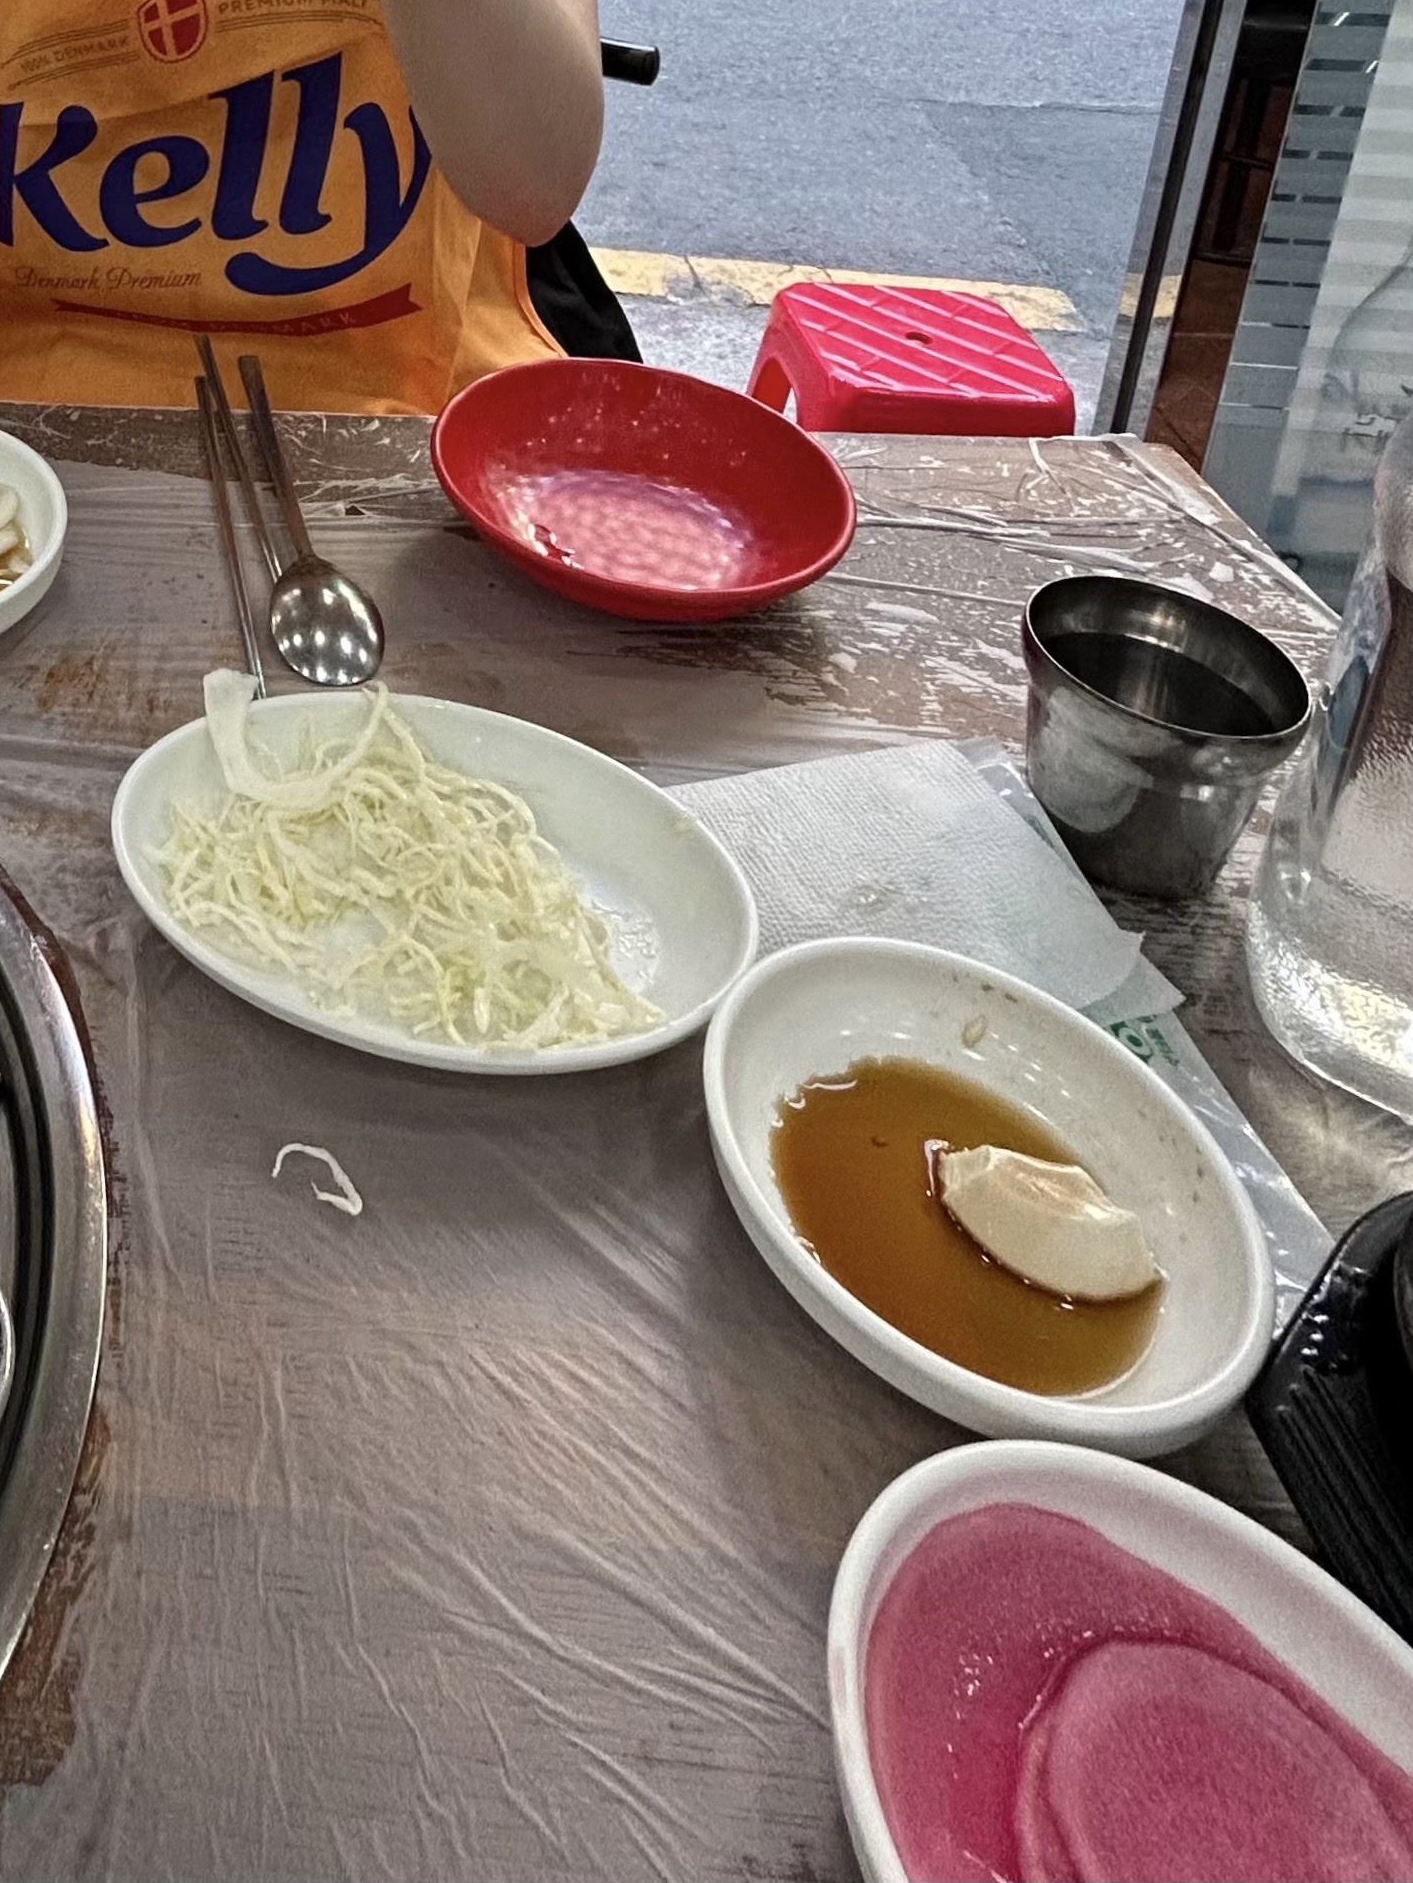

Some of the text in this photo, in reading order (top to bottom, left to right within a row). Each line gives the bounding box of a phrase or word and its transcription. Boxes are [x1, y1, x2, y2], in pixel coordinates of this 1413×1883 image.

[52, 35, 130, 62] DENMARK
[14, 266, 203, 291] Denmark Premium
